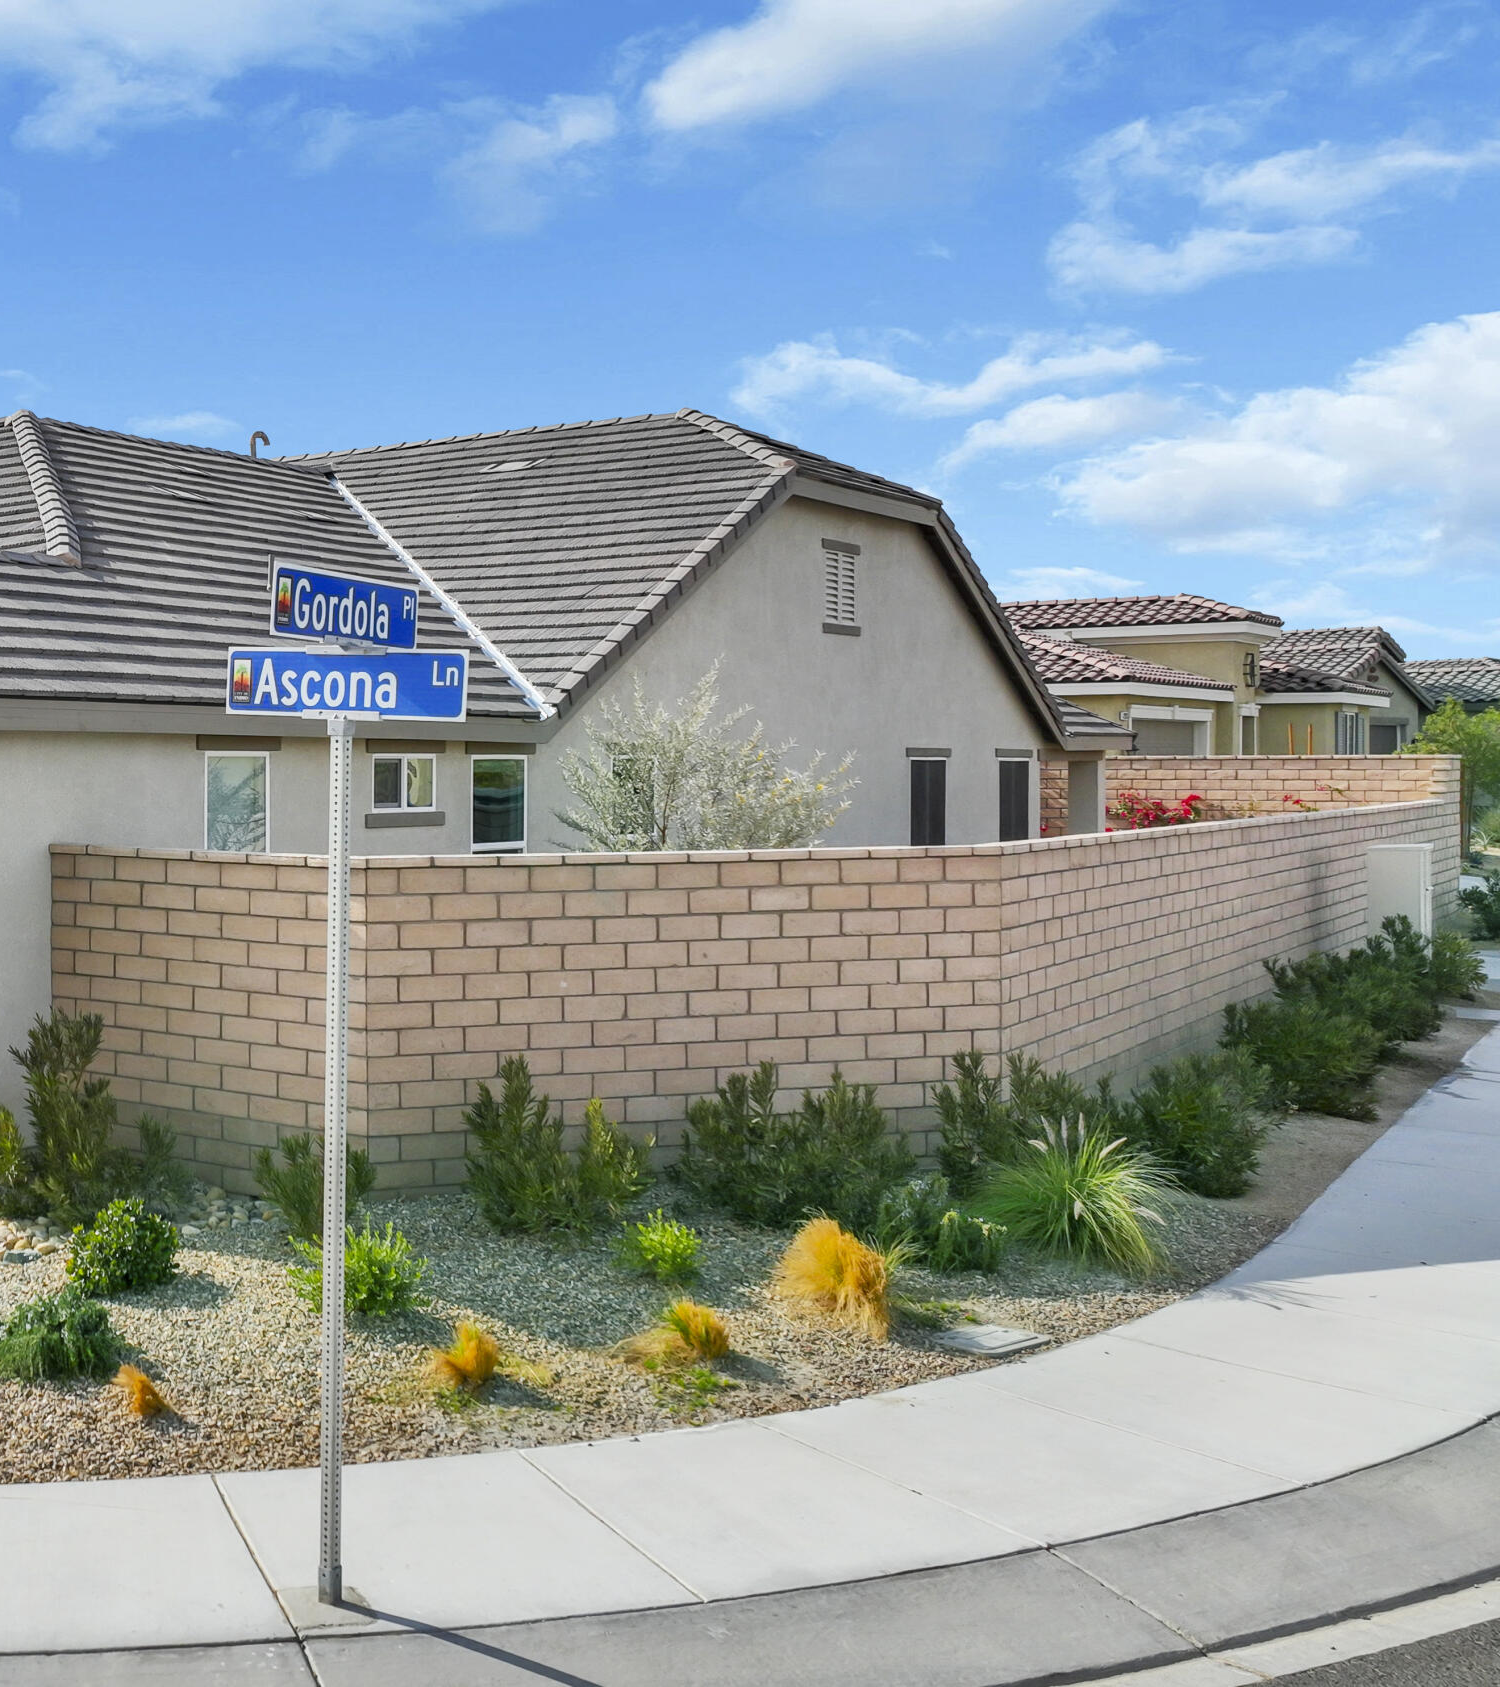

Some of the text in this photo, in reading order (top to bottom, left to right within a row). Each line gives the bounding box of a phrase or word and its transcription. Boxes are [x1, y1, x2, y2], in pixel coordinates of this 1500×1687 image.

[294, 578, 415, 640] Gordola Pl
[253, 658, 459, 709] Ascona Ln
